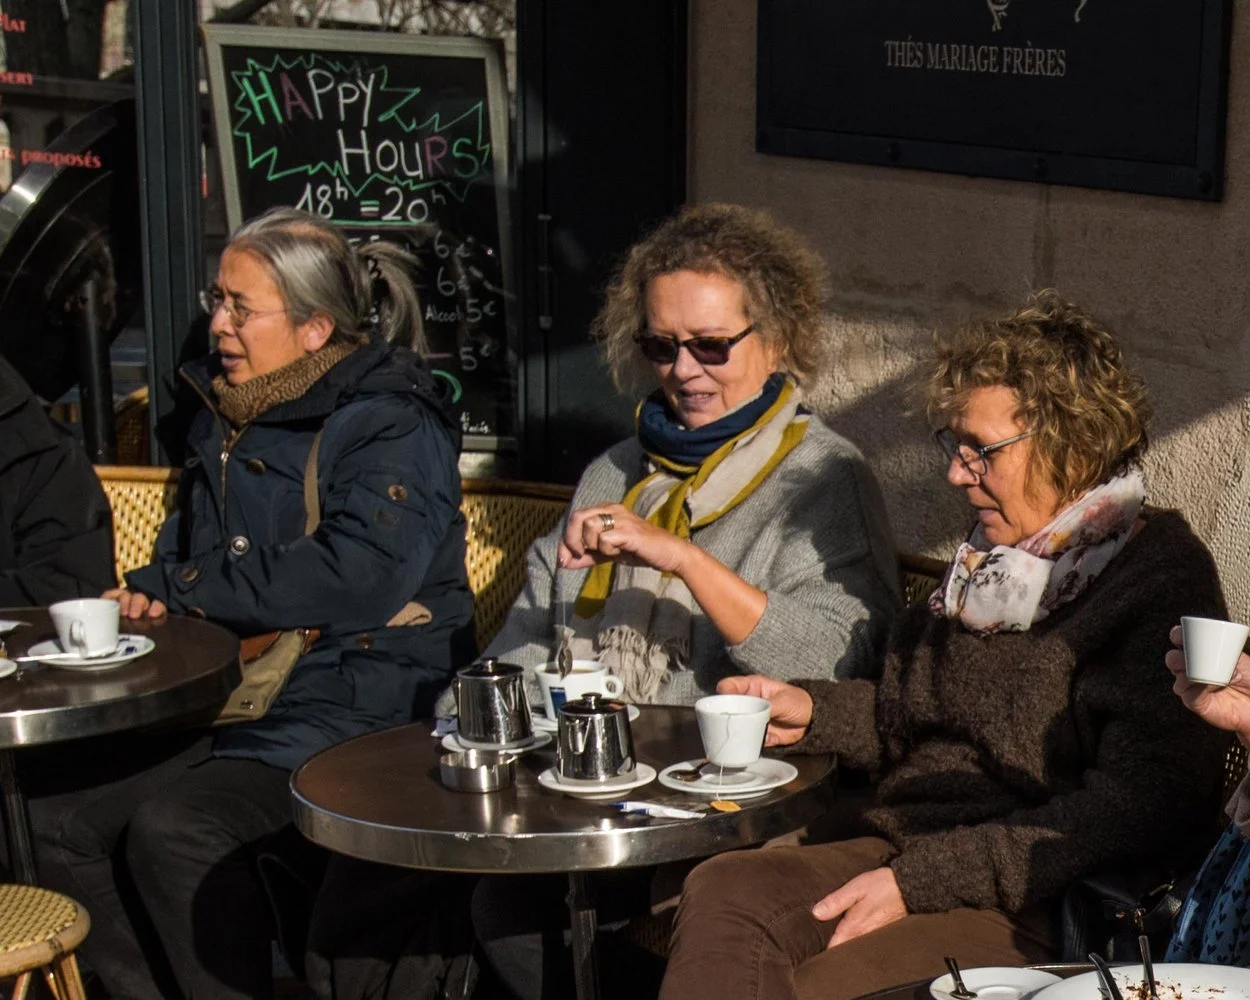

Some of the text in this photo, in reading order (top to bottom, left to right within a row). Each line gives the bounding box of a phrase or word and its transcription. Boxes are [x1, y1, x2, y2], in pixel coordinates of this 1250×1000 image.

[884, 35, 1067, 77] THÉS MARIAGE FRÈRES
